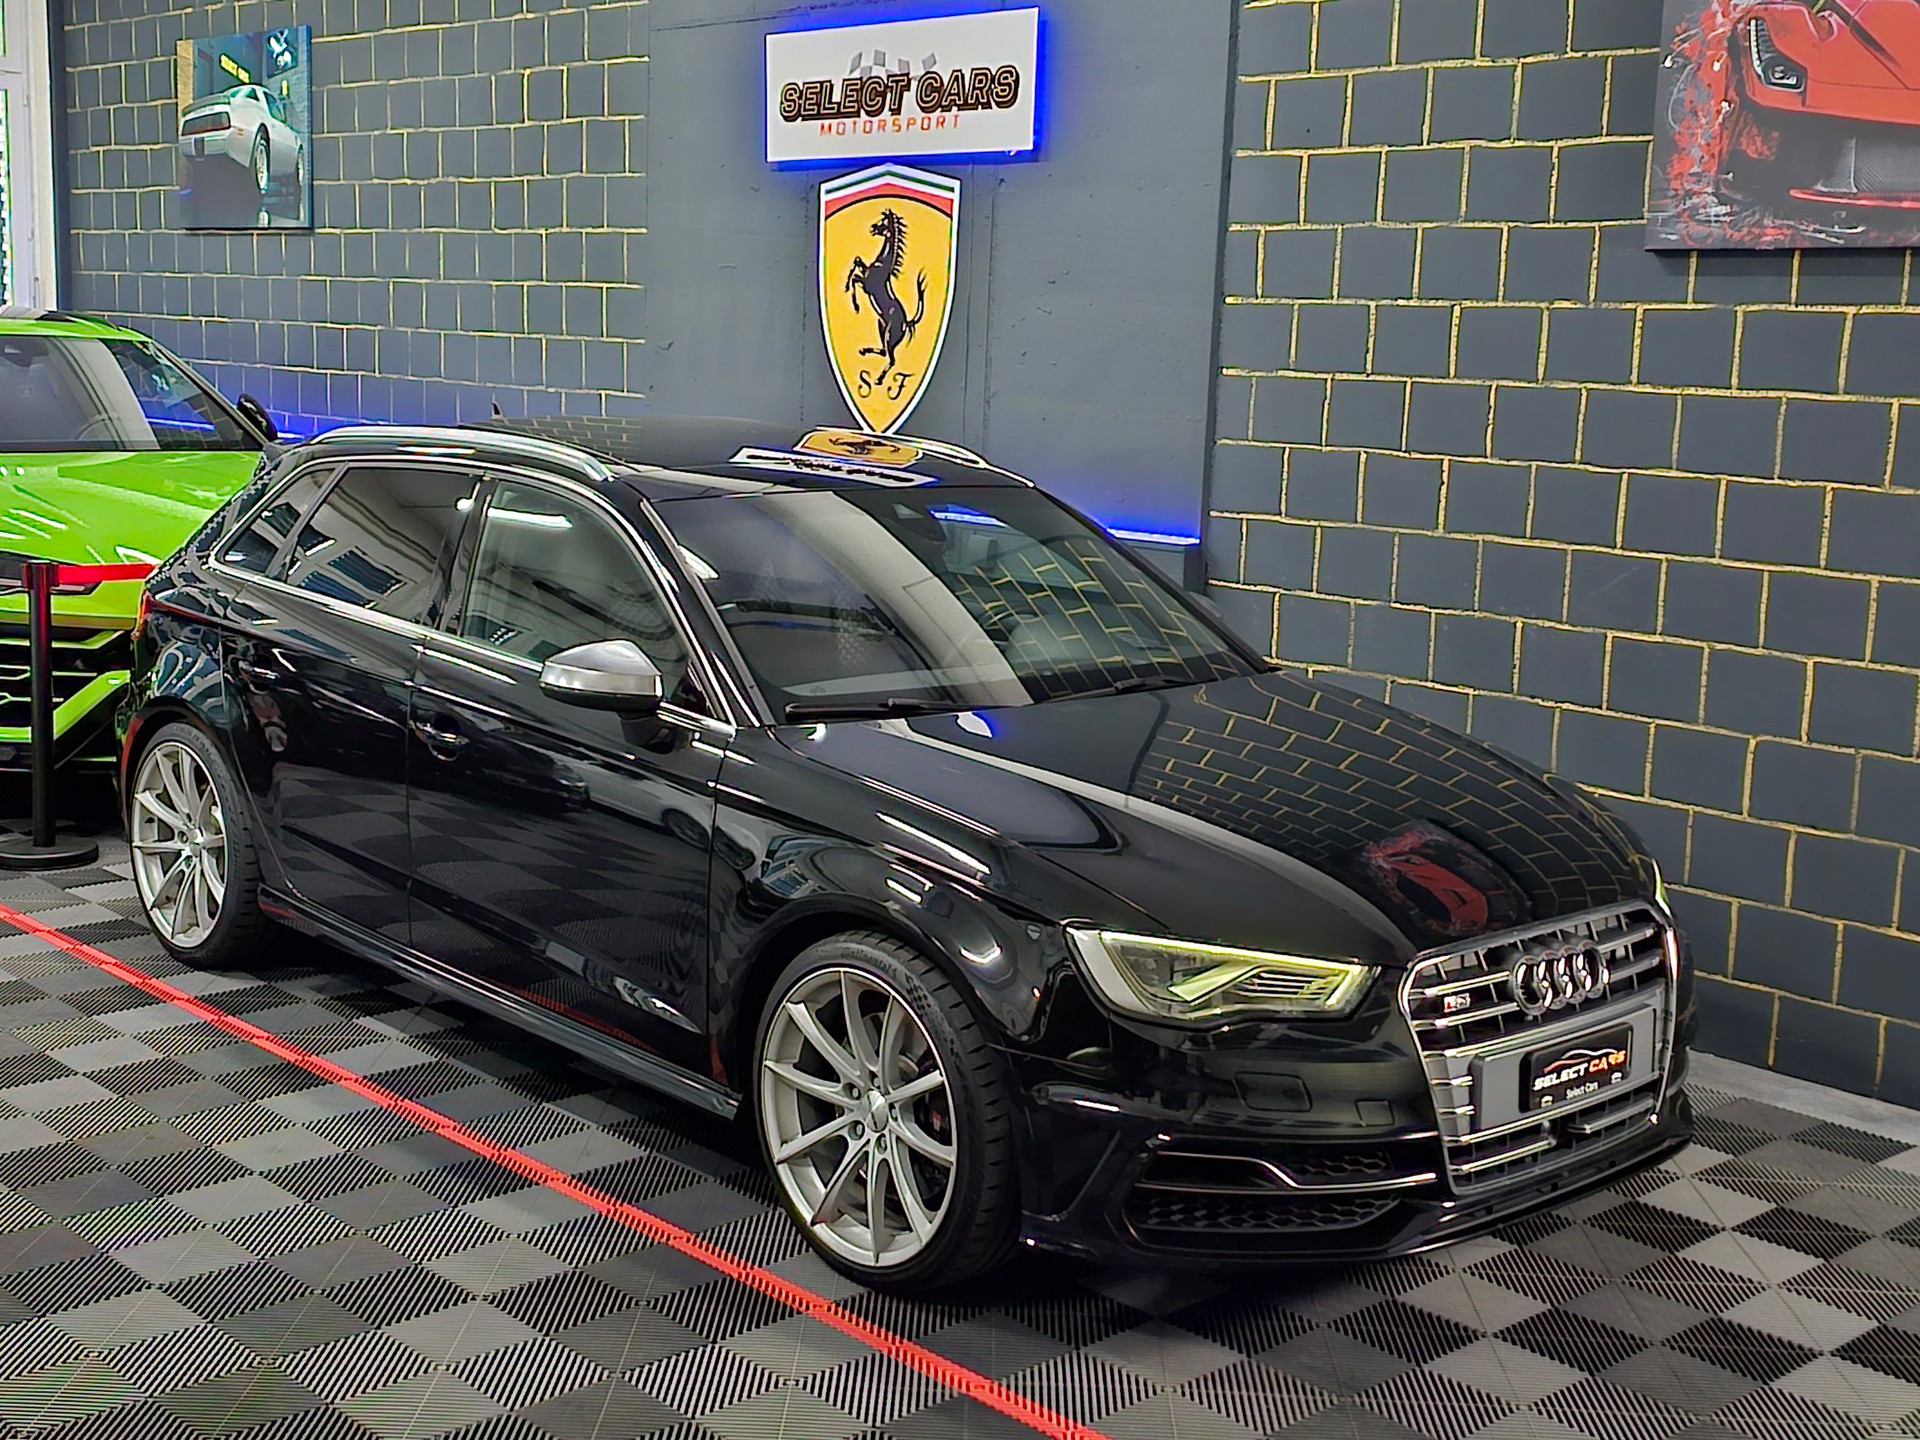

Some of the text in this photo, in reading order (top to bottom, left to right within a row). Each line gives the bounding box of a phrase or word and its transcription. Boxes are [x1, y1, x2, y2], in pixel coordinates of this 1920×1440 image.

[780, 64, 1020, 123] SELECT CARS
[819, 114, 960, 136] MOTORSPORT
[858, 369, 916, 401] S F
[1533, 1062, 1588, 1091] SELECT
